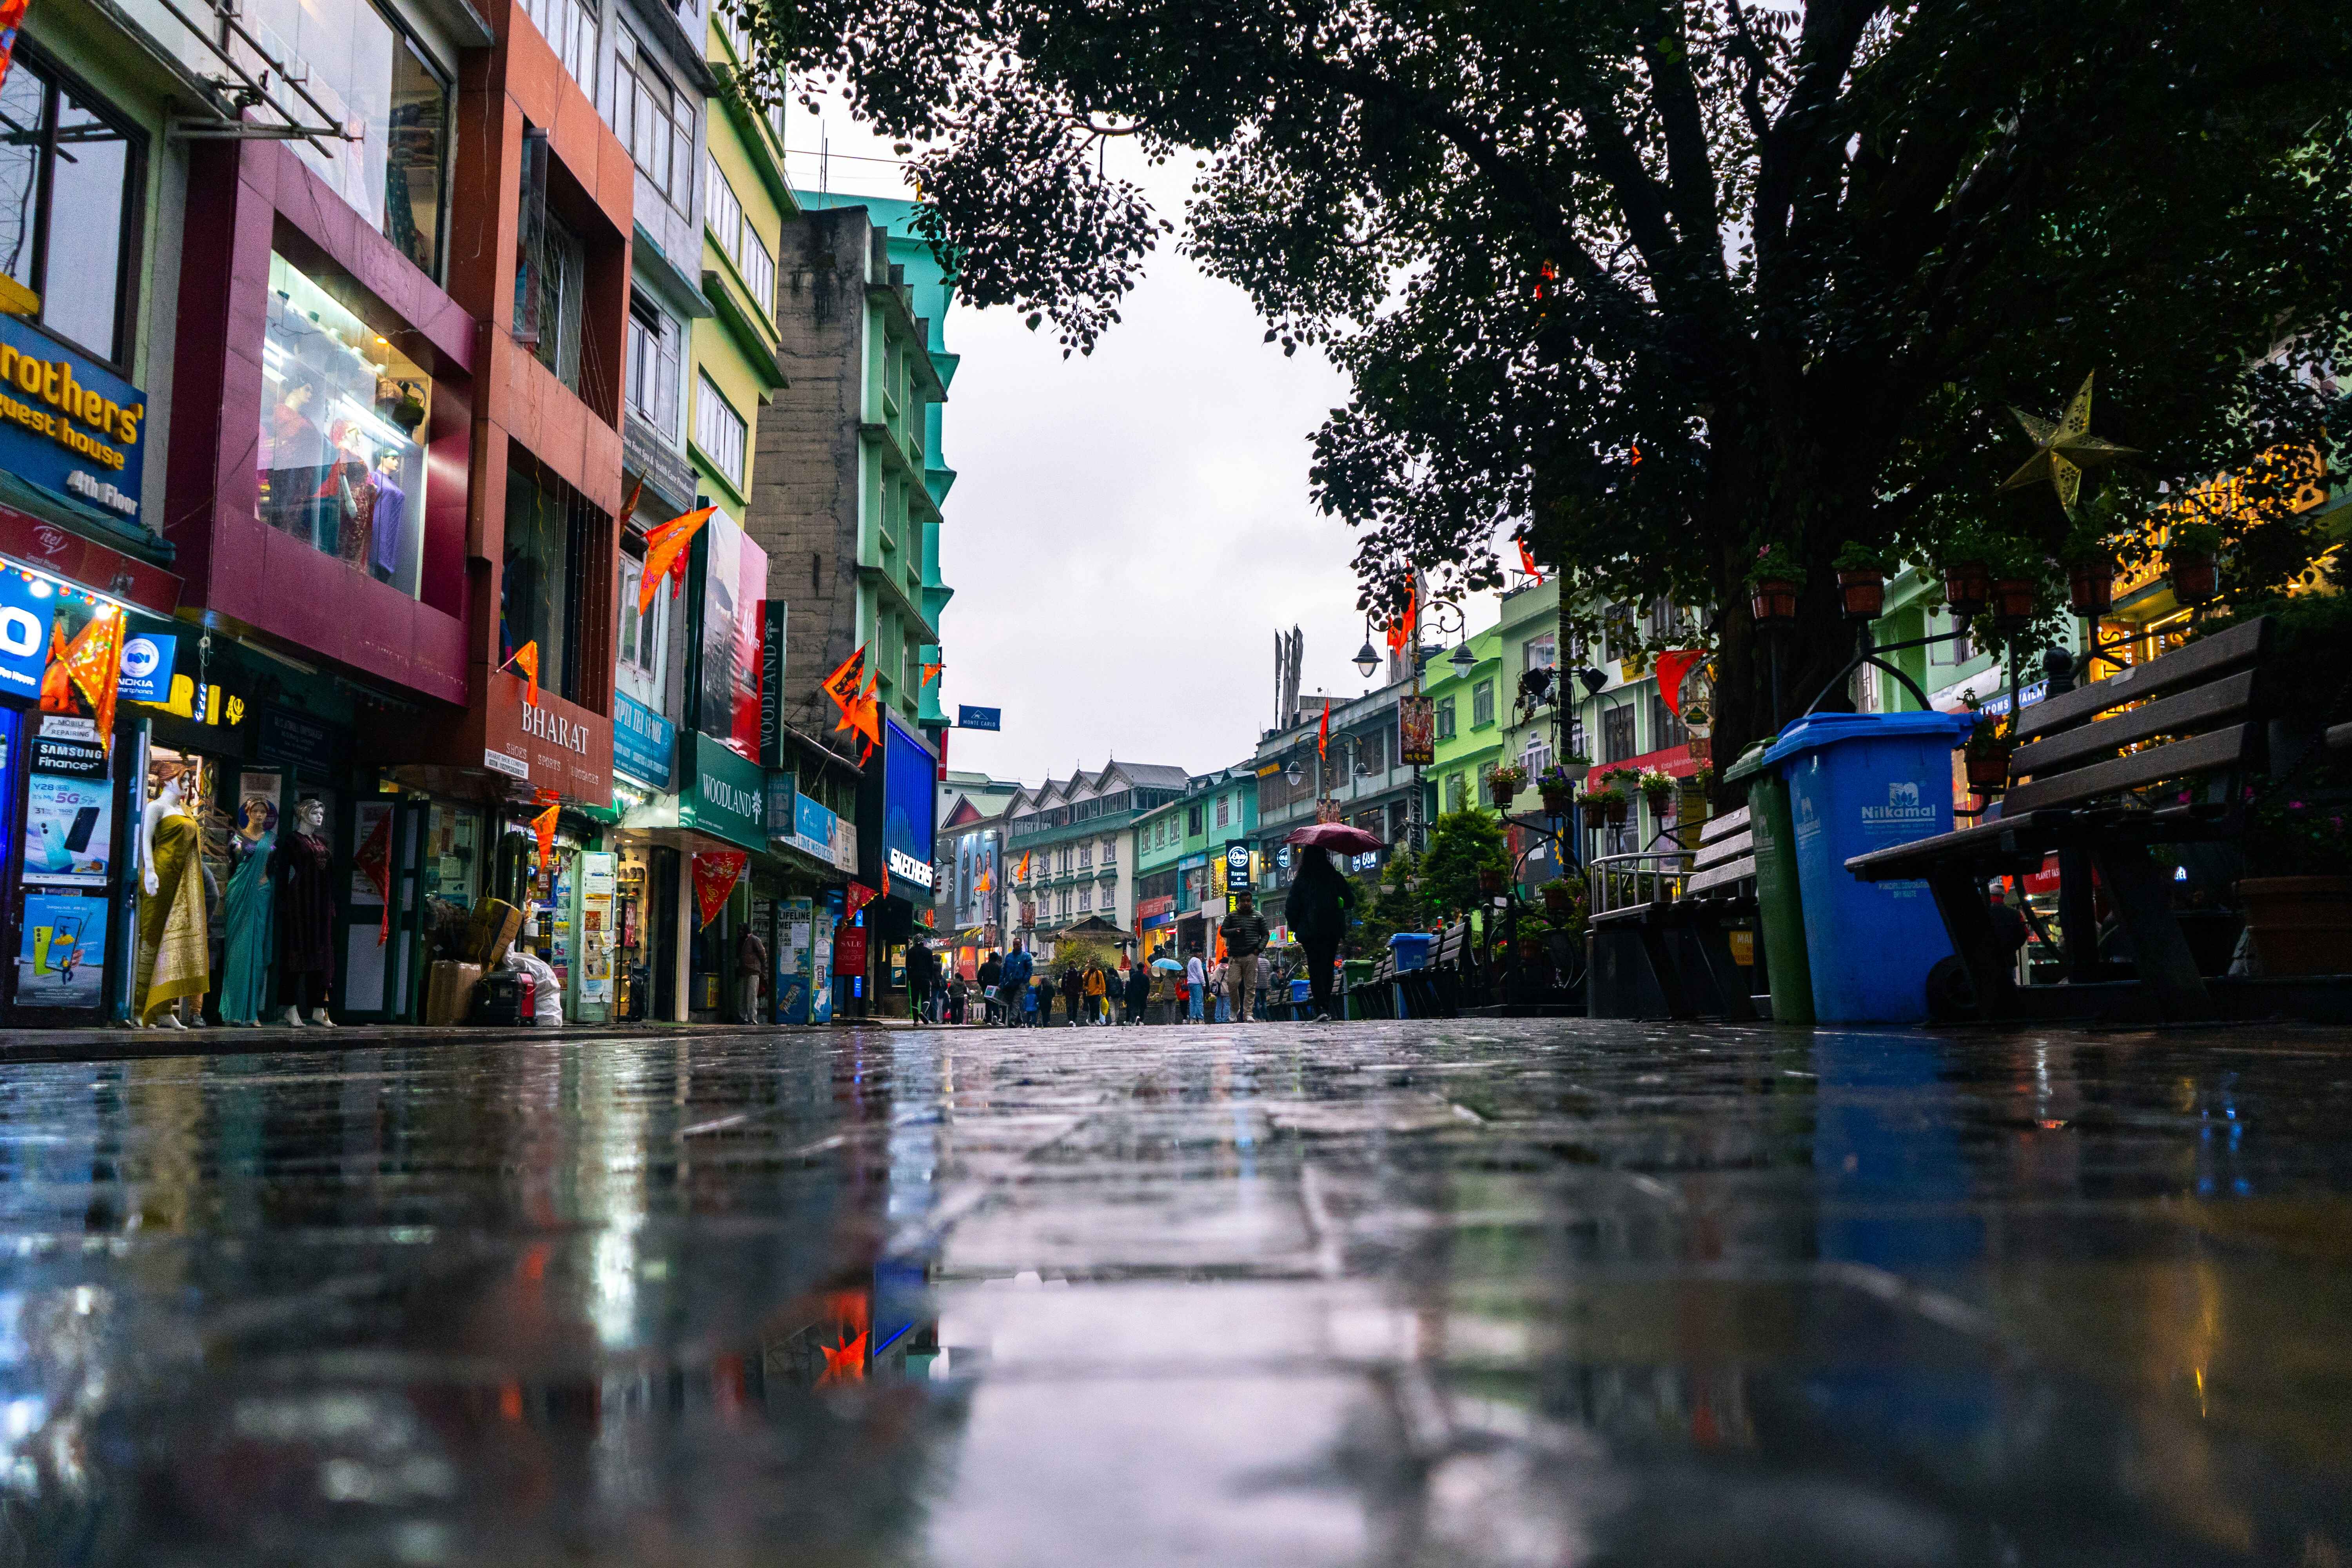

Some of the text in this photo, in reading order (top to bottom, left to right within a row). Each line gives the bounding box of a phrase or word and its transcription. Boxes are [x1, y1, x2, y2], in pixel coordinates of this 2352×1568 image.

[55, 417, 124, 470] house
[67, 470, 138, 515] 4th Floor
[118, 677, 154, 688] NOKIA
[759, 644, 777, 747] WOODLAND
[51, 729, 90, 737] REPAIRING
[521, 700, 589, 755] BHARAT
[40, 744, 102, 759] SAMSUNG
[506, 742, 527, 759] SHOES
[537, 754, 561, 771] SPORTS
[571, 766, 599, 785] LUGGAGES
[55, 792, 80, 804] 5G
[703, 773, 751, 817] WOODLAND
[1862, 804, 1936, 818] Nilkamal
[810, 843, 834, 860] MEDICOS
[889, 848, 933, 888] SKECHERS
[2035, 869, 2051, 881] PLANET
[779, 911, 811, 920] LIFELINE
